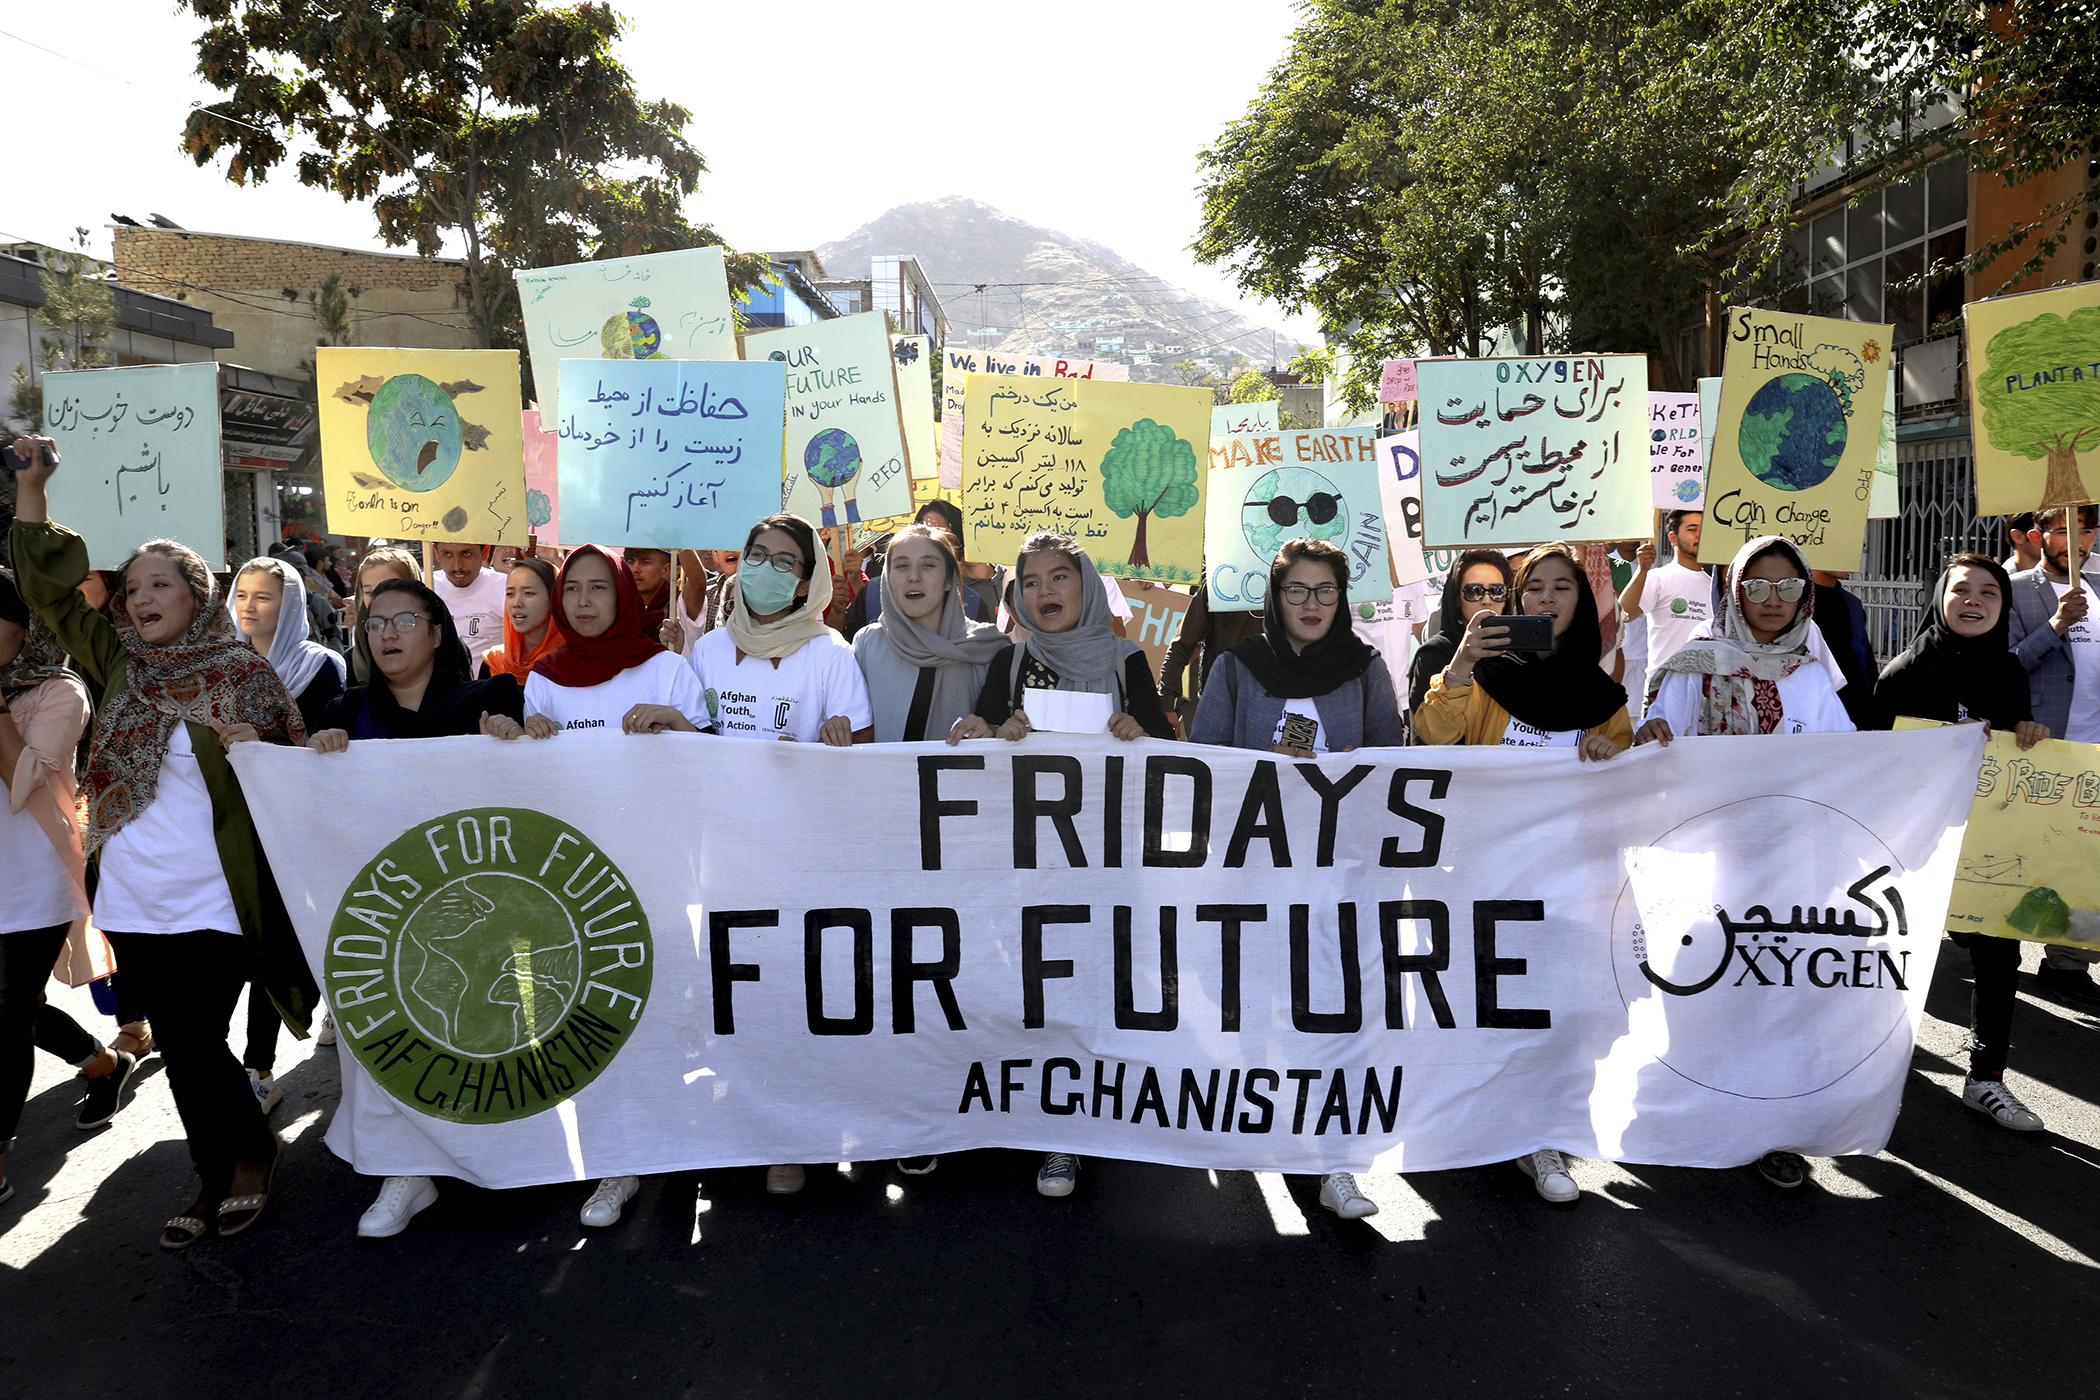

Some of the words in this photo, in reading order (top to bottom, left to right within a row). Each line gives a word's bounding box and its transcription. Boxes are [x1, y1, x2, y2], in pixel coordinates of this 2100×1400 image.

[1732, 311, 1804, 350] Small
[949, 353, 977, 372] We
[985, 355, 1016, 375] live
[1024, 361, 1041, 377] in
[1752, 343, 1810, 370] Hands
[786, 366, 862, 400] FUTURE
[2005, 366, 2069, 394] PLANT
[2073, 366, 2083, 382] A
[588, 379, 630, 410] محیط
[631, 386, 653, 417] از
[657, 380, 748, 420] حفاظت
[792, 405, 804, 418] IN
[810, 398, 842, 420] your
[850, 391, 886, 406] Hands
[989, 385, 1030, 417] درختم
[1032, 387, 1063, 412] یک
[1060, 398, 1078, 411] من
[1437, 387, 1546, 428] حمایت
[1554, 376, 1625, 423] برای
[48, 396, 80, 432] زمین
[80, 392, 129, 433] خوب
[136, 405, 194, 432] دوست
[558, 414, 621, 450] خودمان
[628, 427, 644, 449] از
[655, 428, 669, 452] را
[981, 421, 992, 437] به
[998, 418, 1041, 442] نزدیک
[1045, 424, 1083, 446] سالانه
[684, 437, 742, 465] زیست
[977, 444, 1028, 469] اکسیجن
[1031, 453, 1056, 472] لیتر
[1208, 436, 1283, 470] MAKE
[1295, 434, 1376, 463] EARTH
[1522, 436, 1588, 475] محیط
[1590, 431, 1620, 480] از
[870, 457, 902, 489] PFO
[966, 475, 996, 492] برابر
[1002, 470, 1022, 490] که
[1058, 476, 1087, 497] تولید
[1855, 468, 1872, 501] PFO
[390, 498, 398, 510] is
[401, 501, 419, 513] on
[625, 461, 692, 533] کنیم
[672, 477, 726, 509] آغاز
[1013, 497, 1057, 518] اکسیجن
[1053, 506, 1063, 519] به
[1065, 508, 1093, 519] است
[1713, 488, 1766, 528] Can
[400, 516, 439, 535] Danger!!
[1085, 523, 1109, 538] فقط
[720, 691, 757, 703] Afghan
[721, 704, 749, 716] Youth
[566, 718, 605, 730] Afghan
[726, 720, 757, 732] Action
[917, 755, 1452, 871] FRIDAYS
[332, 858, 422, 1040] FRIDAYS
[425, 816, 517, 874] FOR
[538, 831, 646, 1021] FUTURE
[708, 907, 967, 1035] FOR
[1022, 899, 1552, 1034] FUTURE
[363, 1005, 621, 1113] AFGHANISTAN
[958, 1057, 1403, 1137] AFGHANISTAN
